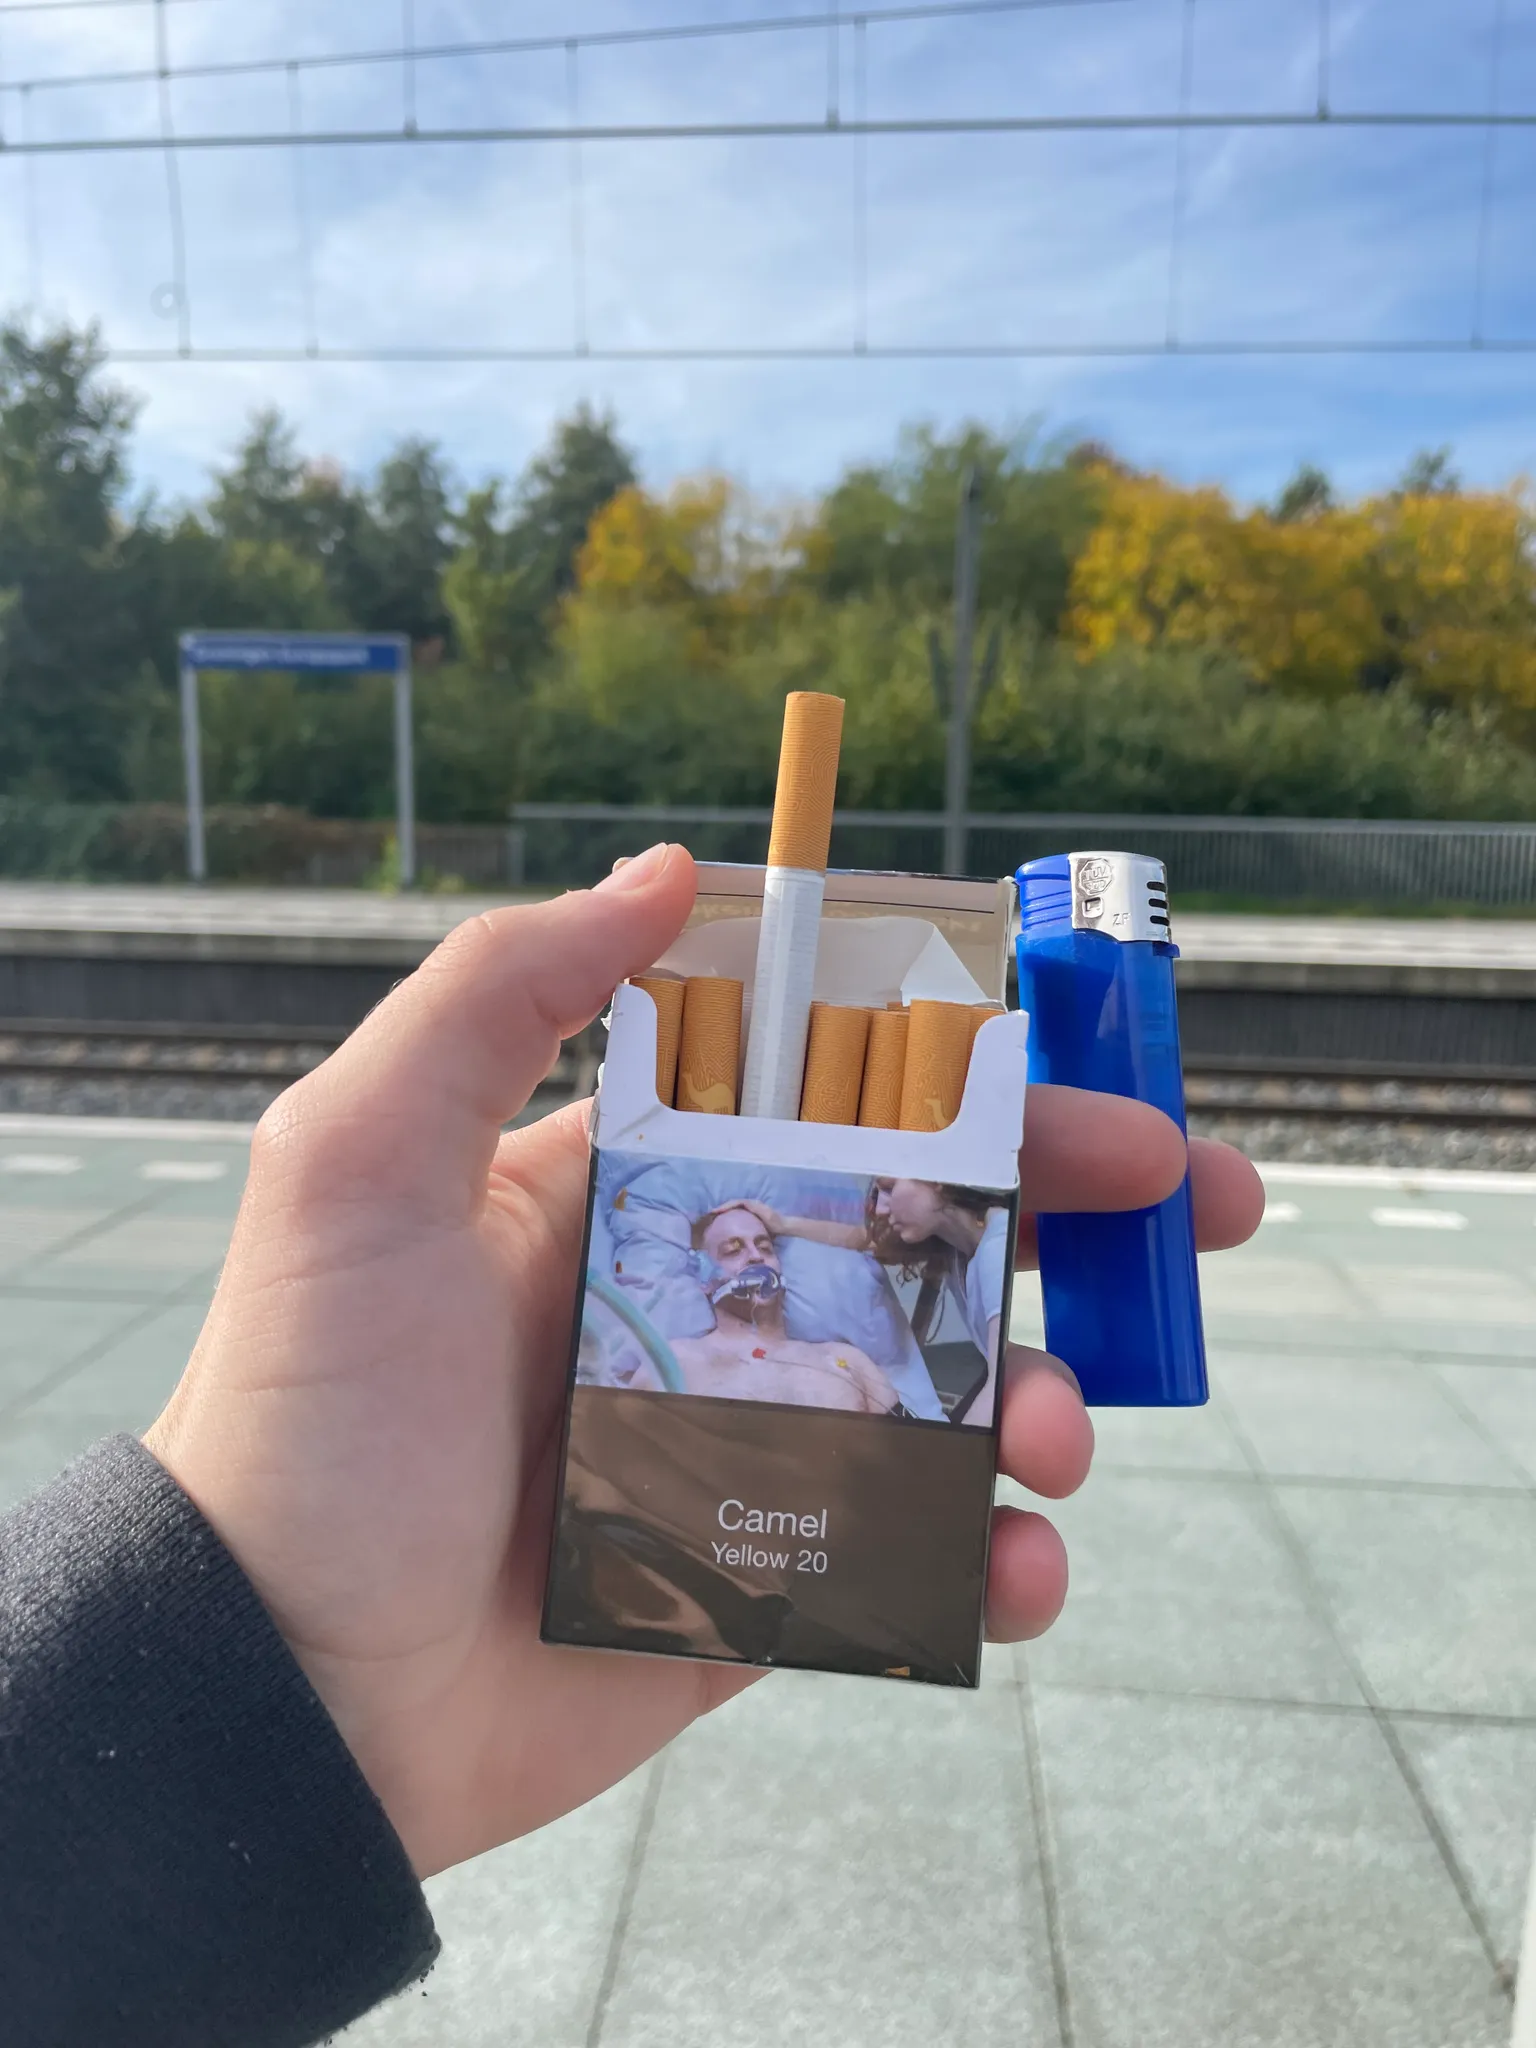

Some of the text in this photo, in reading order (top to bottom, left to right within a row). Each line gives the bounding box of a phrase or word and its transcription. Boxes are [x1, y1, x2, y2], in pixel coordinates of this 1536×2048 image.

[718, 1499, 828, 1539] Camel
[711, 1541, 828, 1574] Yellow 20
